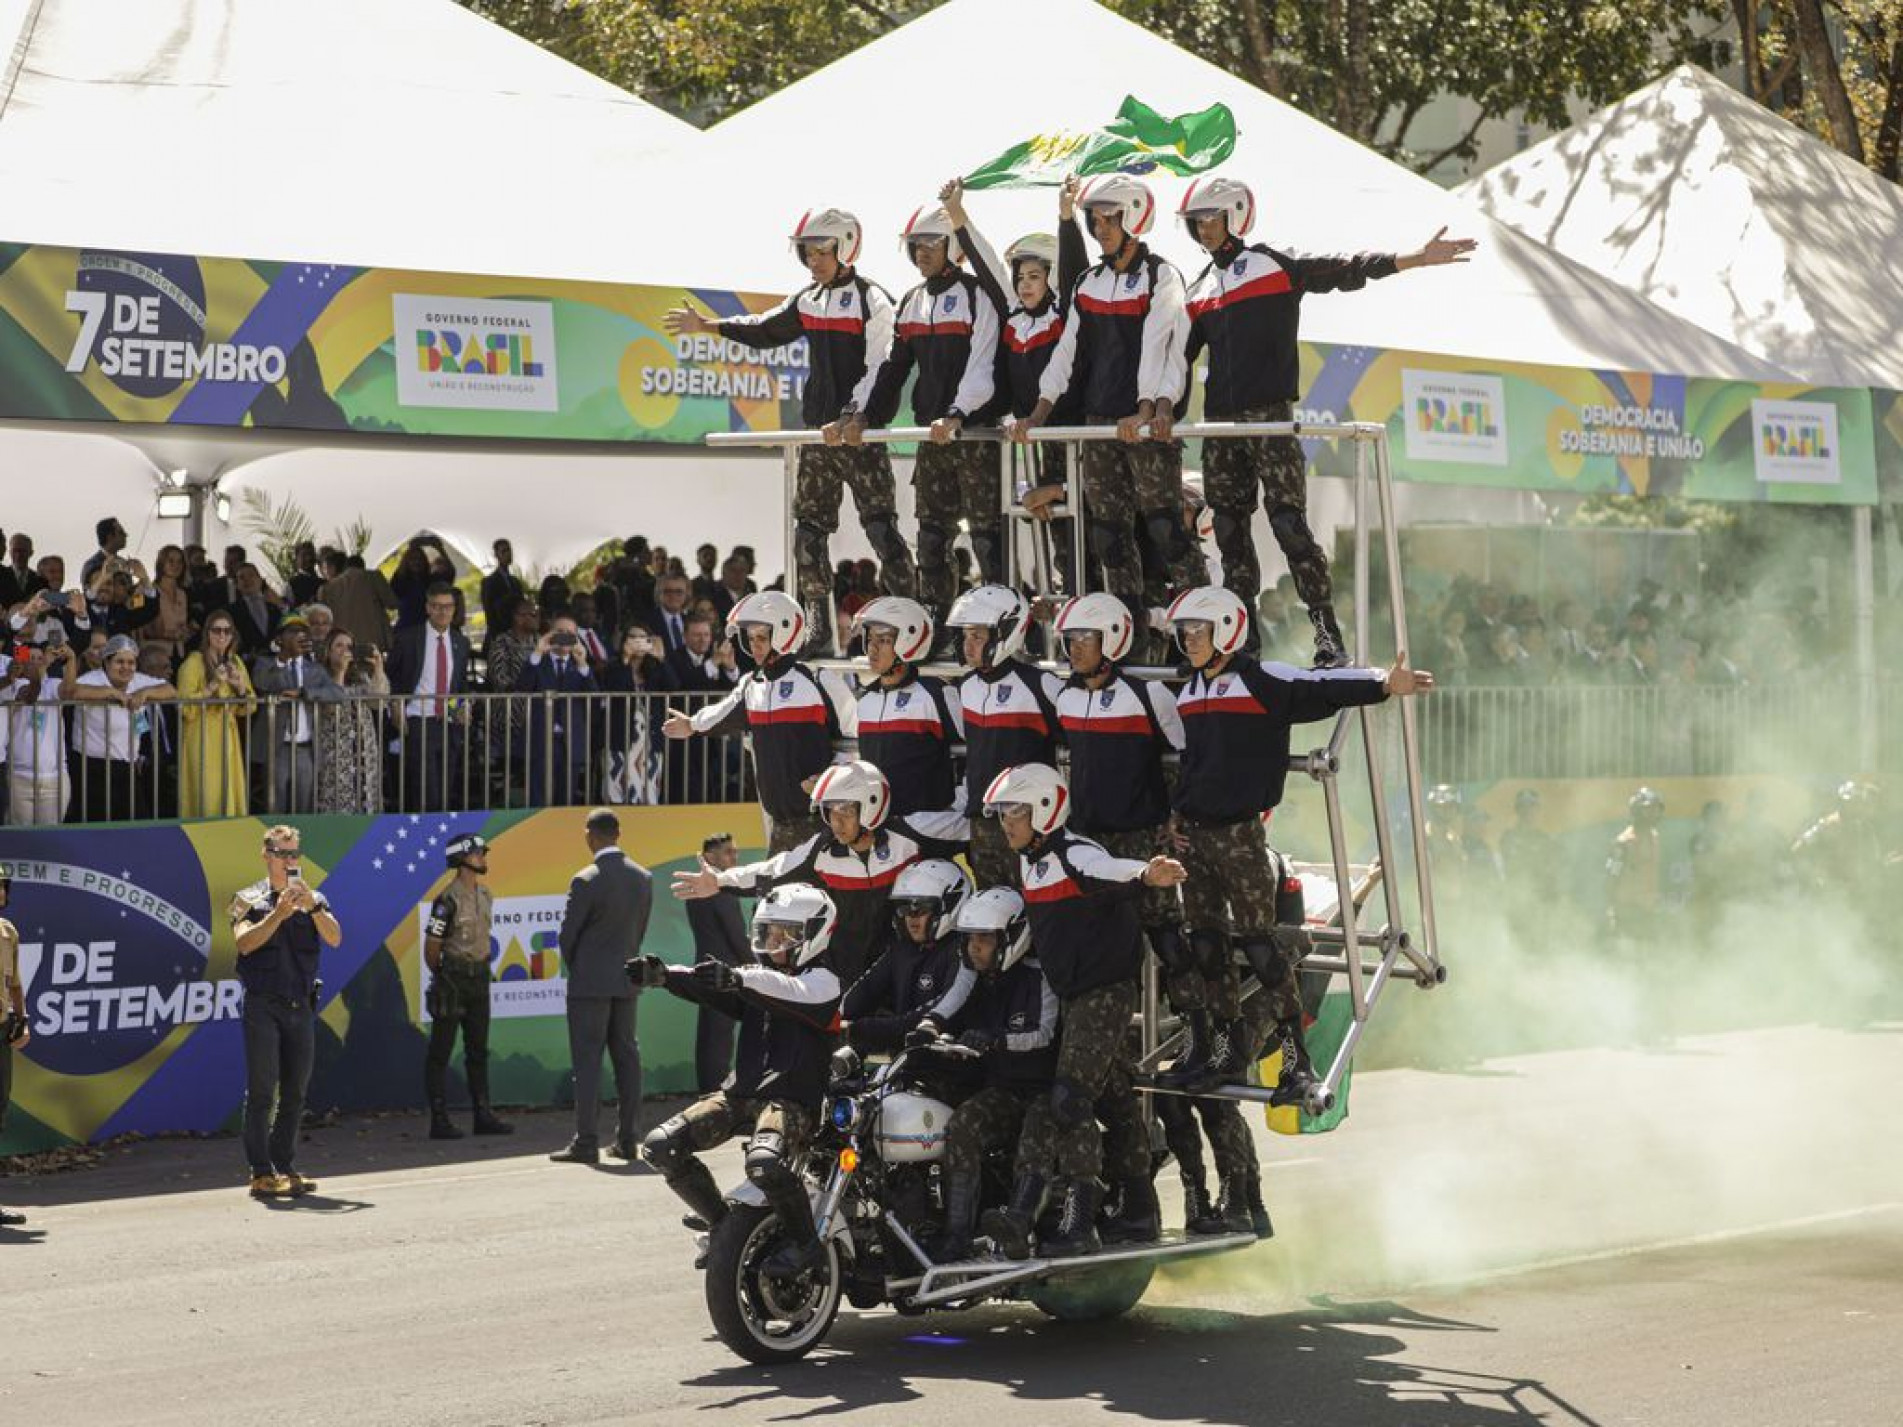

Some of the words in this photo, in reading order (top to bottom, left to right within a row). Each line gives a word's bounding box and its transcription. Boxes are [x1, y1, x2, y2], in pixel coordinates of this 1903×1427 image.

[65, 290, 106, 373] 7
[112, 294, 160, 335] DE
[425, 313, 478, 326] GOVERNO
[483, 315, 532, 328] FEDERAL
[100, 337, 287, 383] SETEMBRO
[415, 328, 544, 378] BRASIL
[641, 366, 772, 399] SOBERANIA
[777, 374, 791, 400] E
[1560, 430, 1642, 456] SOBERANIA
[1657, 432, 1704, 460] UNIÃO
[60, 867, 71, 884] E
[83, 871, 208, 948] PROGRESSO
[51, 941, 117, 985] DE
[33, 978, 246, 1037] SETEMBR
[504, 988, 565, 1001] RECONSTR
